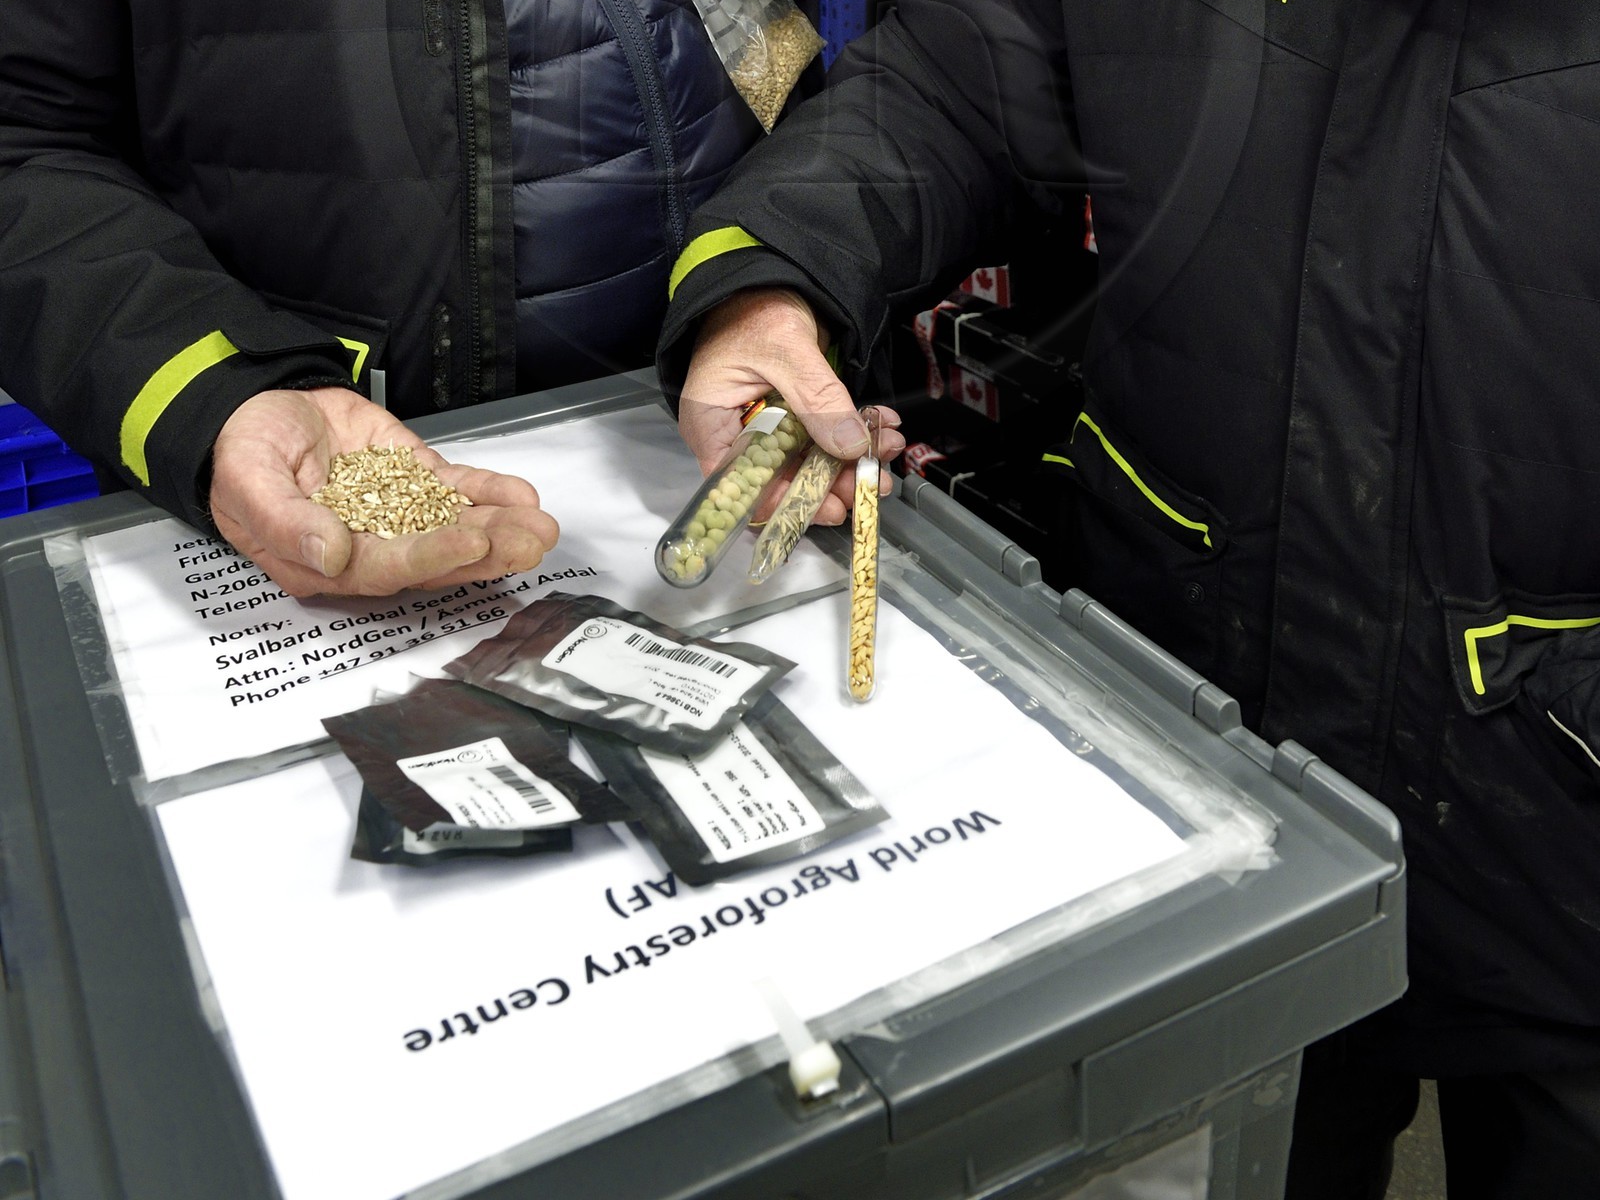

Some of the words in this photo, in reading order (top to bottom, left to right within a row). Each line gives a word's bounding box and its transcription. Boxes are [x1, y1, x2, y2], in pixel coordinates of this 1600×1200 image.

[185, 559, 254, 584] Garde
[195, 589, 290, 620] Telepho
[208, 620, 293, 646] Notify:
[216, 625, 323, 670] Svalbard
[329, 607, 405, 632] Global
[412, 586, 468, 612] Seed
[224, 661, 295, 689] Attn.:
[302, 623, 411, 666] NordGen
[420, 616, 427, 631] /
[537, 566, 598, 586] Asdal
[230, 675, 311, 707] Phone
[318, 657, 361, 678] +47
[369, 646, 400, 662] 91
[406, 631, 436, 649] 36
[440, 618, 472, 634] 51
[476, 607, 507, 623] 66
[555, 637, 588, 664] NordGen
[868, 810, 1003, 872] World
[584, 857, 861, 984] Agroforestry
[603, 872, 681, 920] AF)
[402, 976, 572, 1053] Centre
